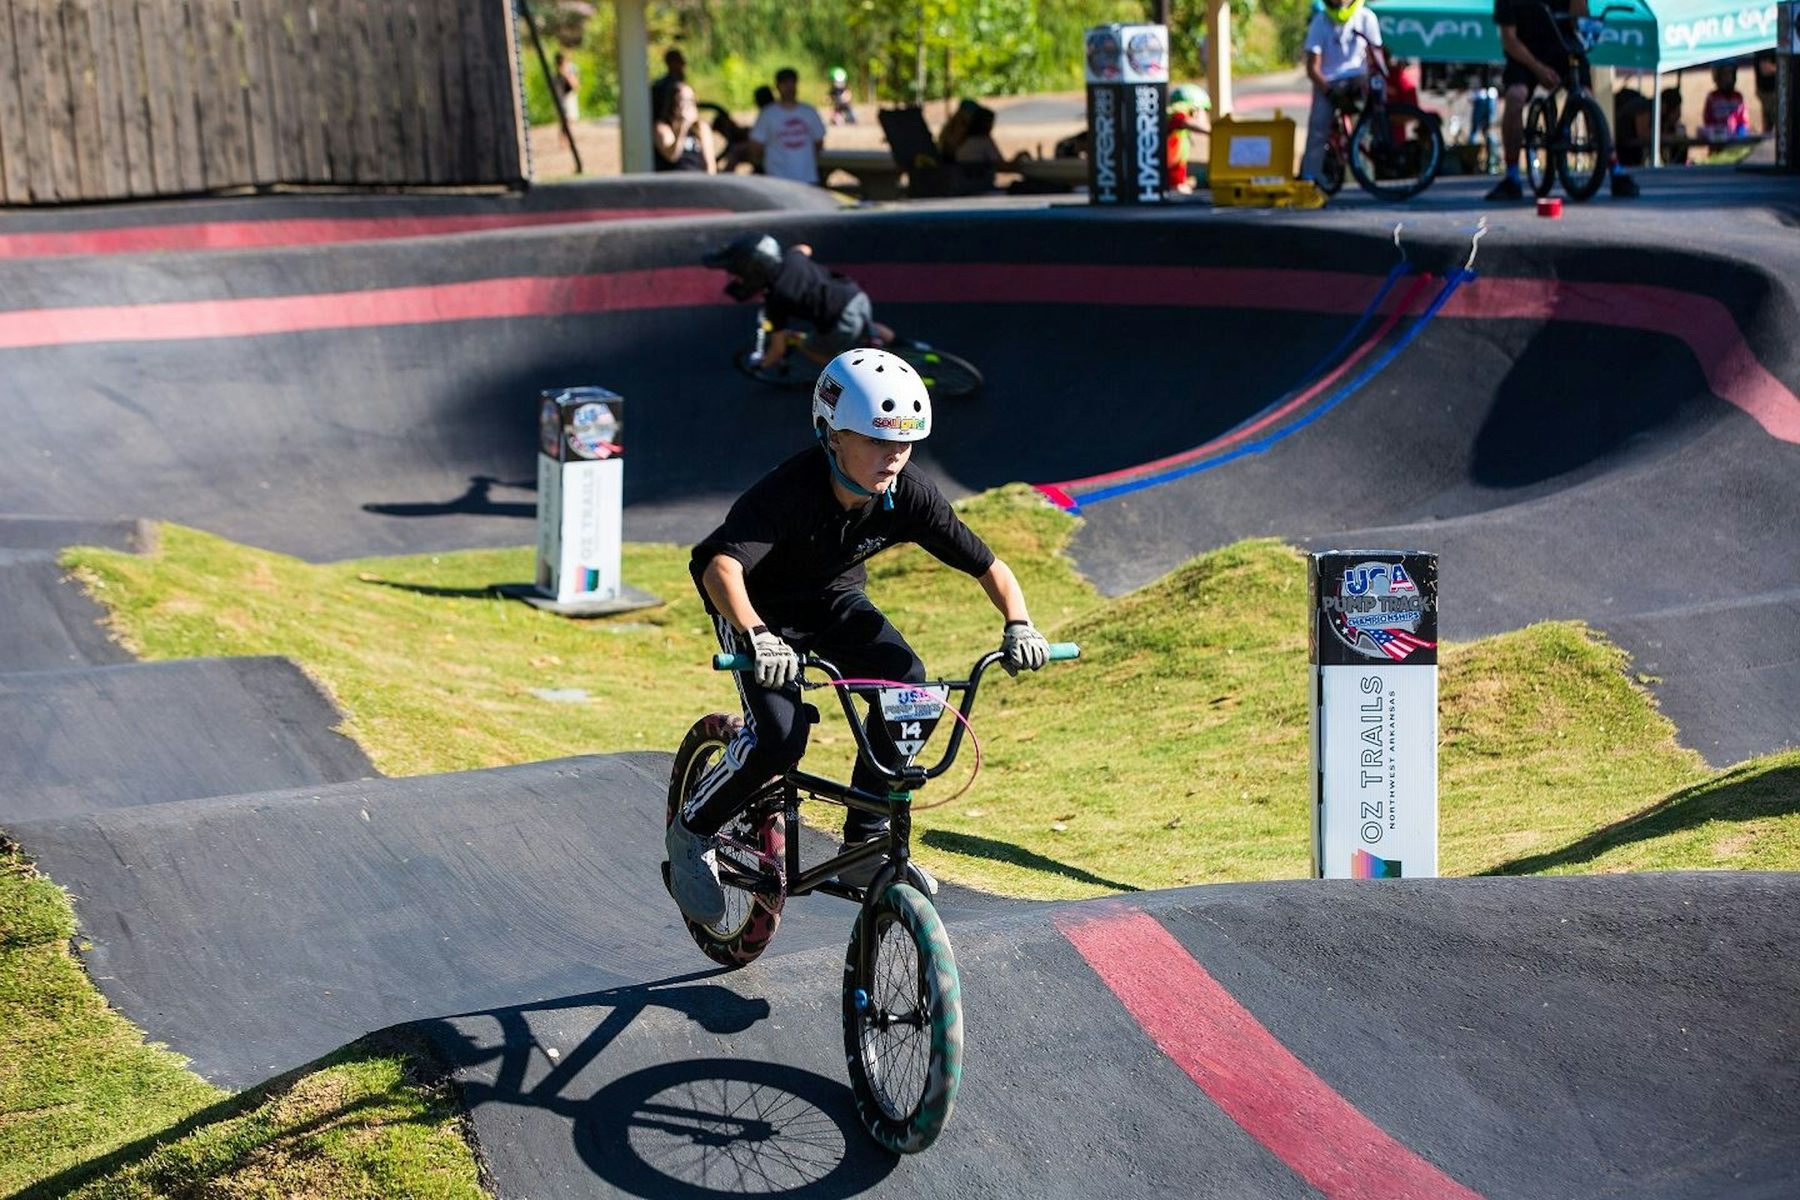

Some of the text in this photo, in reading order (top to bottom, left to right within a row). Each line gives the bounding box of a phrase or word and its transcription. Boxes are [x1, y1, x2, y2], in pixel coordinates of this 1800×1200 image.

[1322, 594, 1433, 613] PUMP TRACK
[1347, 611, 1421, 627] CHAMPIONSHIPS
[900, 721, 923, 740] 14
[1360, 675, 1384, 844] OZ TRAILS
[1388, 690, 1396, 830] NORTHWEST ARKANSAS
